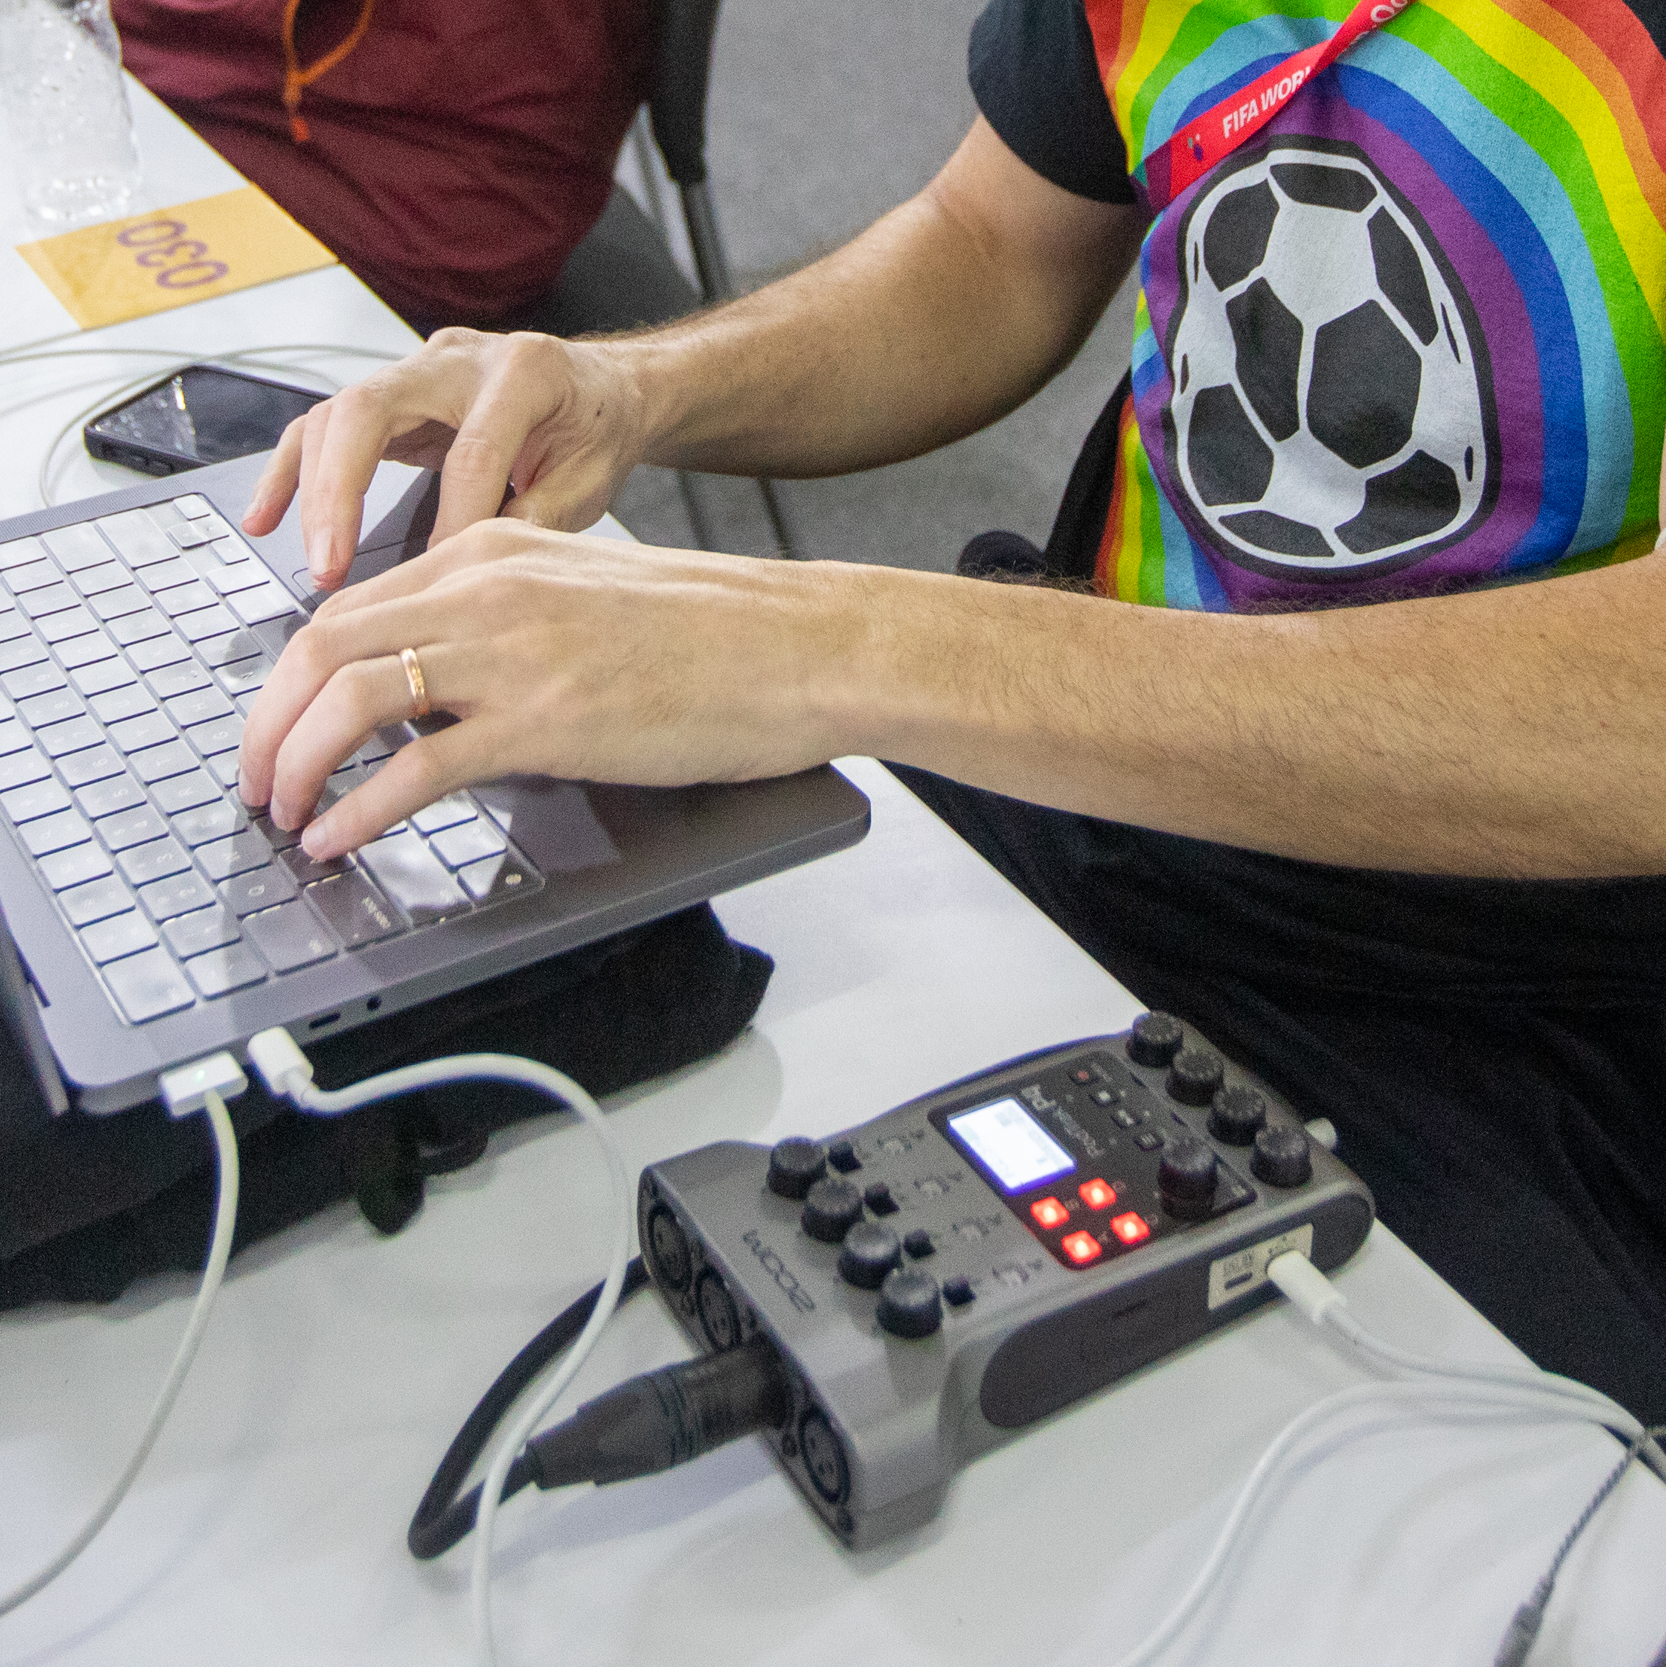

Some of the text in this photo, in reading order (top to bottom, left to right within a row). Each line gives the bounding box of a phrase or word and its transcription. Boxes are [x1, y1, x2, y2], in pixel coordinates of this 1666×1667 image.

[1221, 99, 1260, 139] FIFA
[117, 219, 229, 289] 030
[741, 1228, 815, 1312] ZOOM
